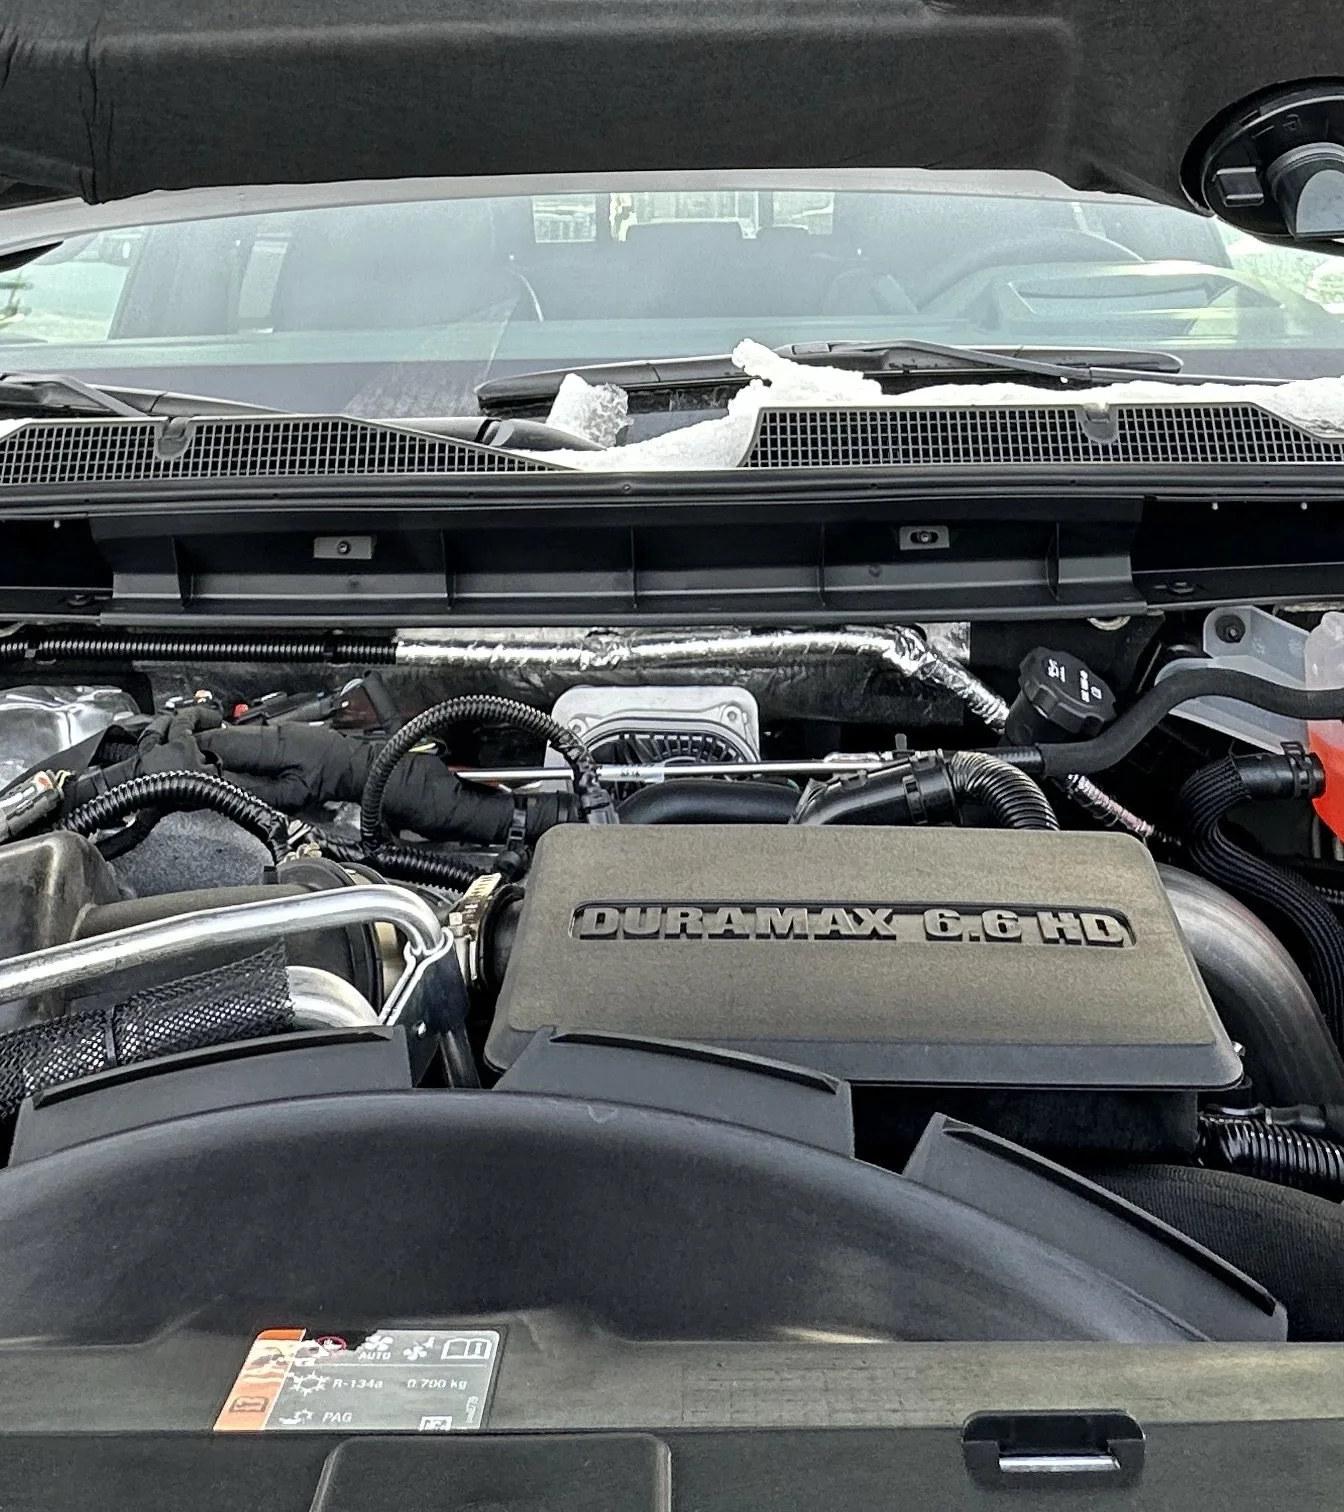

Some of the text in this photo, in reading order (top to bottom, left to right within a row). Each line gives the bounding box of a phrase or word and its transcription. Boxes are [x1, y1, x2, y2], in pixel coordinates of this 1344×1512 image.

[578, 906, 1125, 948] DURAMAX 6.6 HD
[358, 1351, 392, 1360] AUTO
[332, 1378, 384, 1389] R-134a
[321, 1411, 353, 1423] PAG
